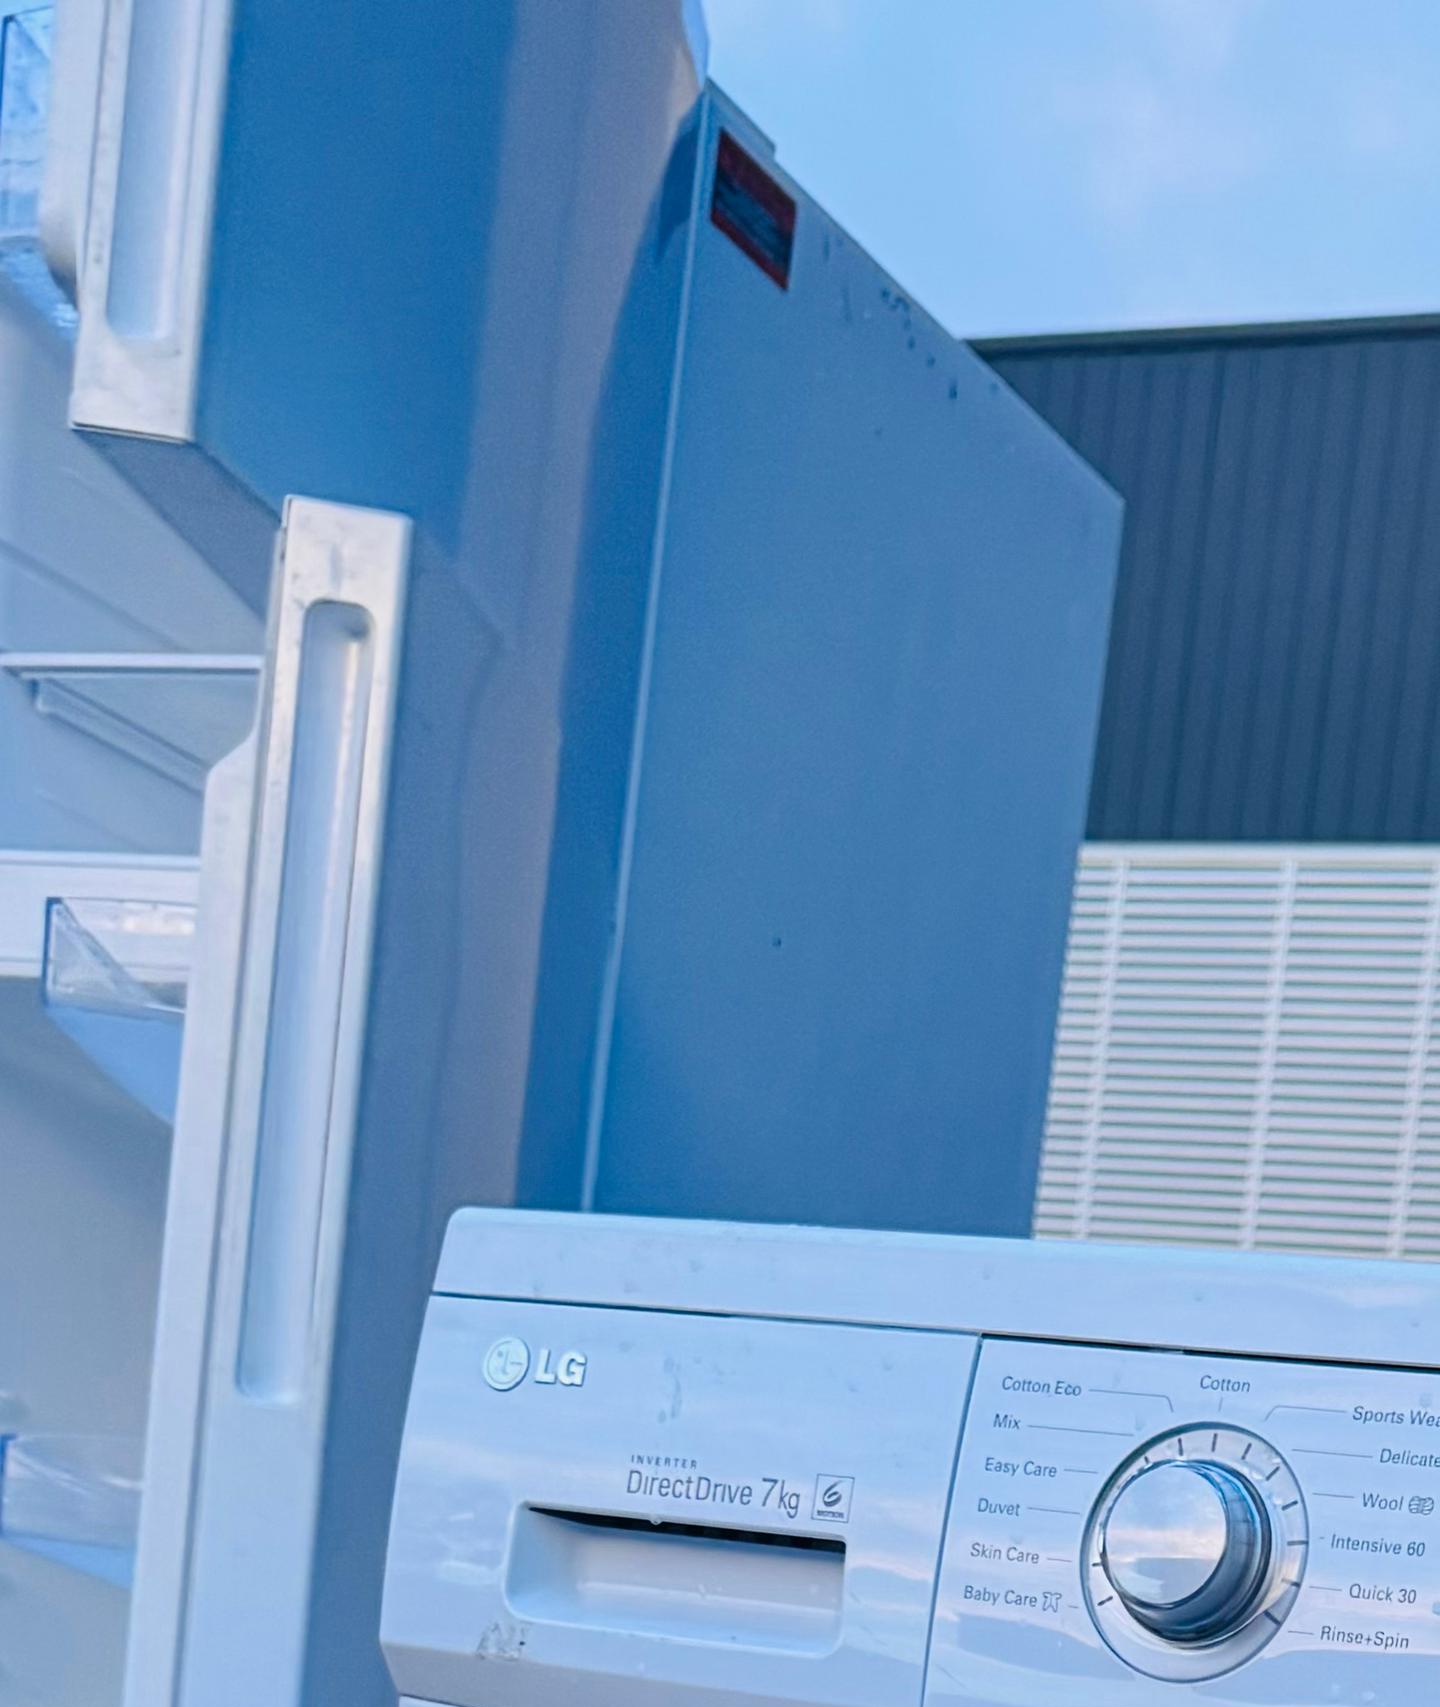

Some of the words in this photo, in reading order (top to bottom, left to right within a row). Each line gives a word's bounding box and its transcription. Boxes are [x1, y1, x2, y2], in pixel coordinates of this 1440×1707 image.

[535, 1349, 587, 1387] LG
[1001, 1375, 1050, 1394] Cotton
[1054, 1380, 1082, 1396] Eco
[1200, 1375, 1250, 1393] Cotton
[993, 1413, 1021, 1430] Mix
[1352, 1406, 1404, 1424] Sports
[631, 1453, 698, 1470] INVERTER
[984, 1457, 1020, 1477] Easy
[1023, 1460, 1058, 1478] Care
[977, 1498, 1021, 1517] Duvet
[1362, 1492, 1404, 1511] Wool
[970, 1542, 1002, 1560] Skin
[1006, 1546, 1040, 1564] Care
[1331, 1533, 1402, 1556] Intensive
[1407, 1541, 1426, 1557] 60
[963, 1584, 1001, 1606] Baby
[1004, 1589, 1038, 1608] Care
[1349, 1583, 1394, 1602] Quick
[1398, 1588, 1418, 1604] 30
[1320, 1625, 1410, 1650] Rinse+Spin
